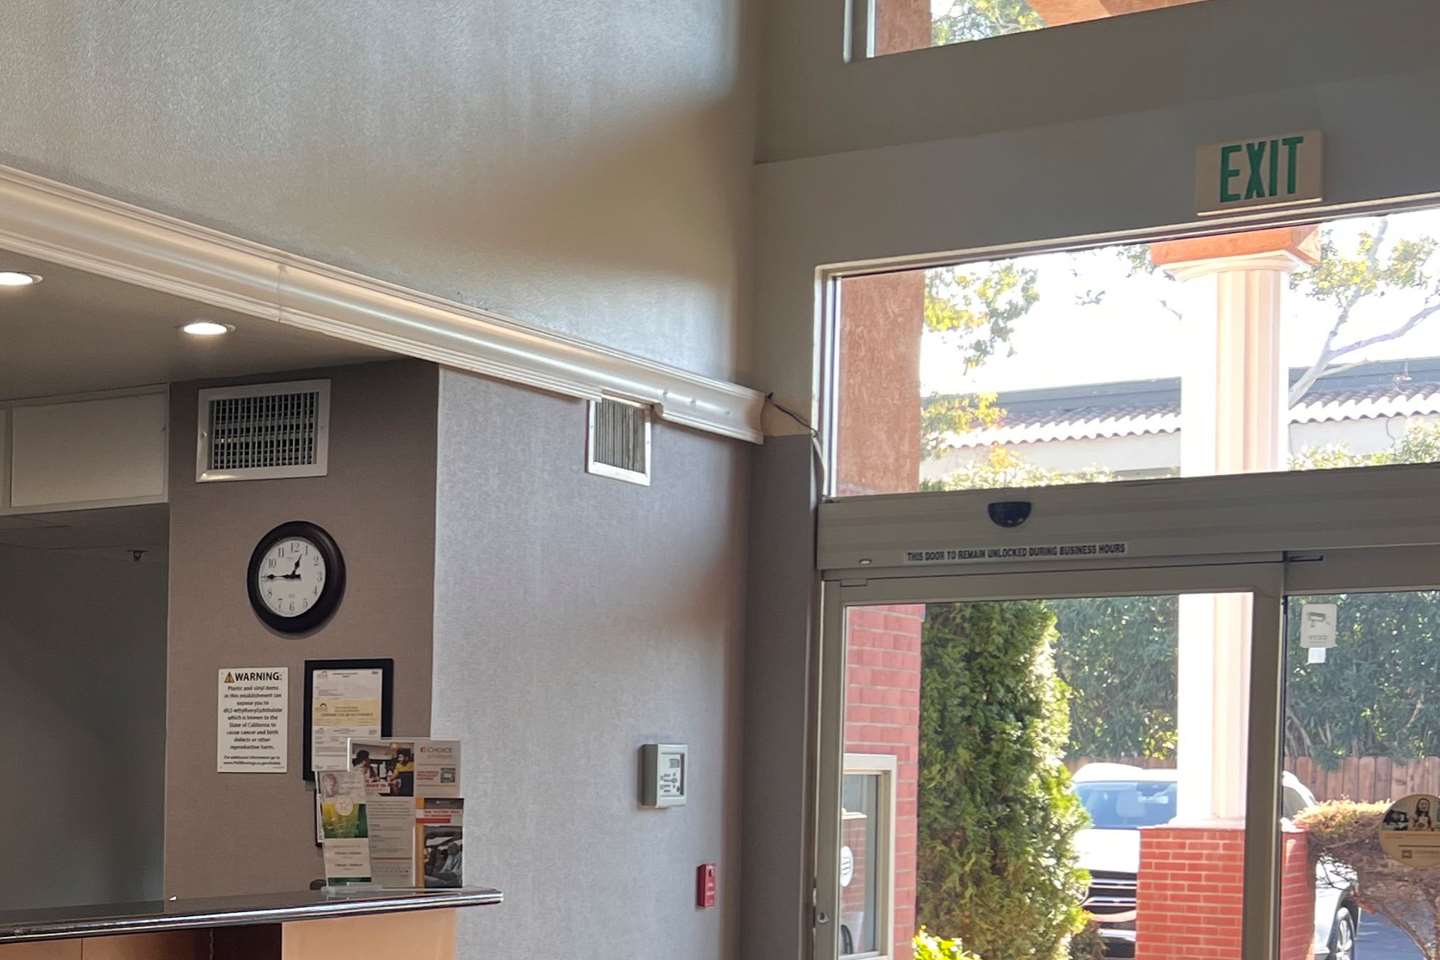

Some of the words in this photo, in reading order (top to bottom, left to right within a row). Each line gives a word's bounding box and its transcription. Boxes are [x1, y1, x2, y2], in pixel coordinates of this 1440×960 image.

[1220, 136, 1304, 203] EXIT
[925, 551, 944, 560] DOOR
[958, 549, 986, 559] REMAIN
[988, 547, 1026, 559] UNLOCKED
[1060, 545, 1096, 556] BUSINESS
[1099, 544, 1125, 554] HOURS
[234, 672, 283, 681] WARNING:
